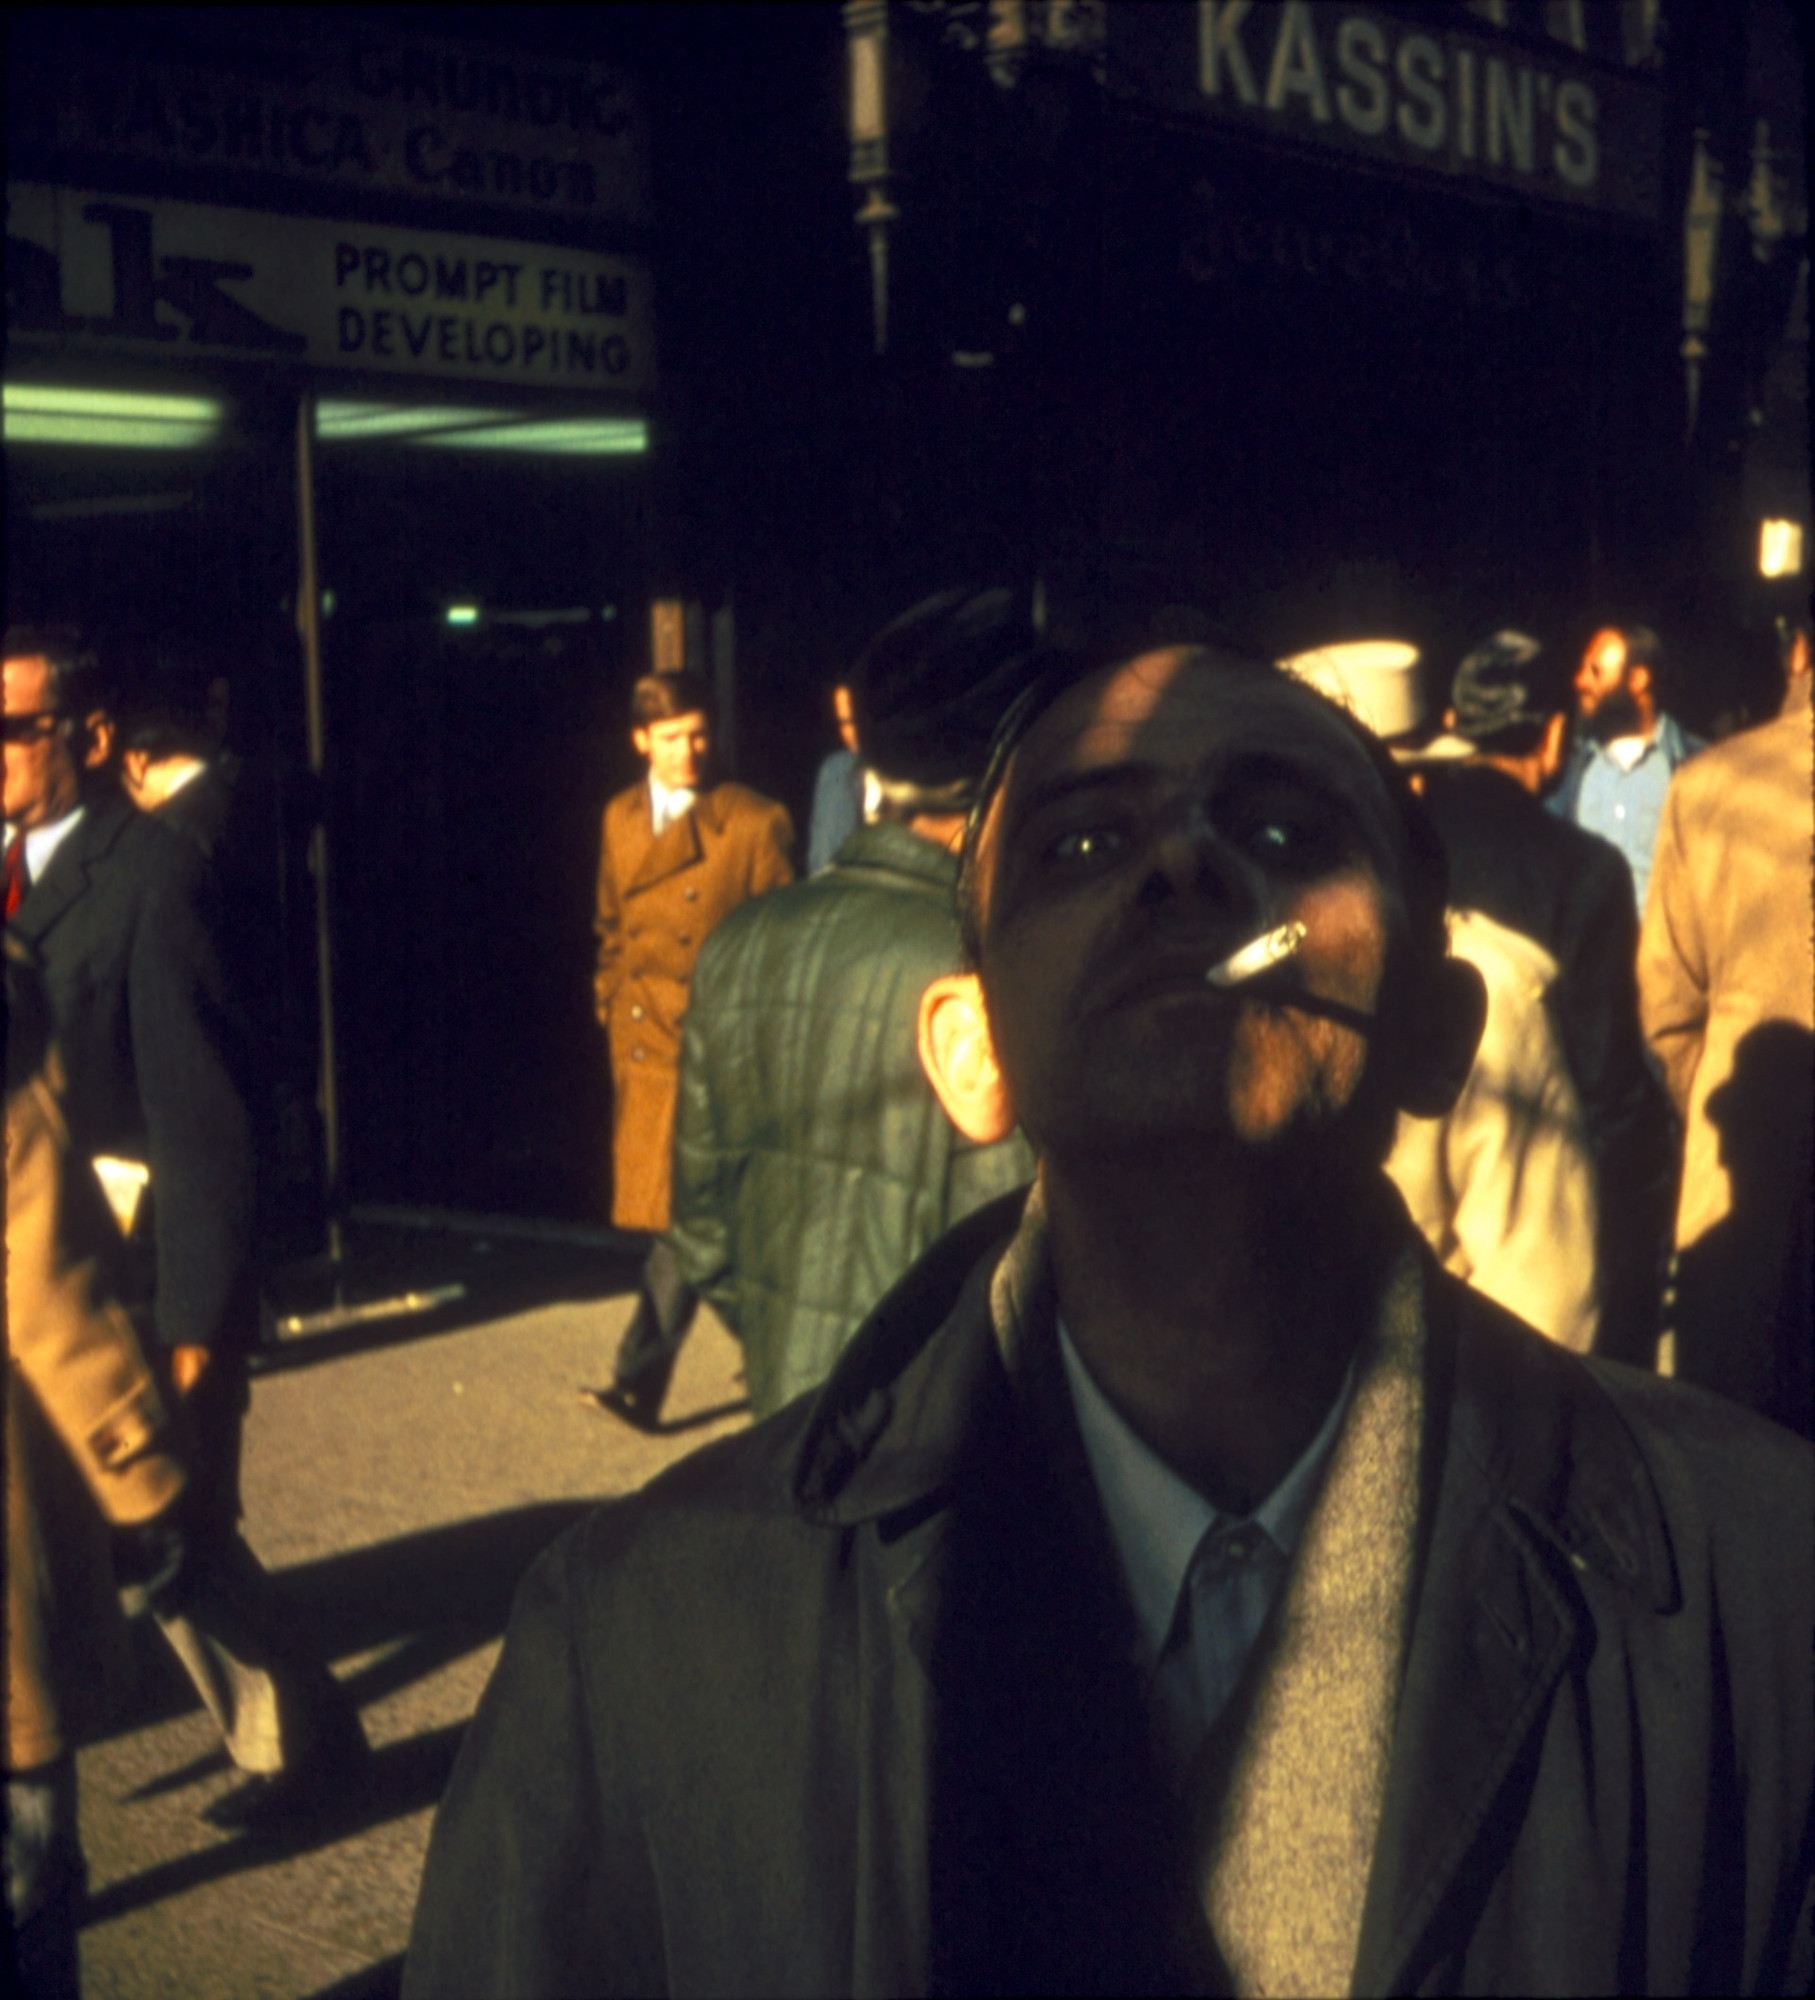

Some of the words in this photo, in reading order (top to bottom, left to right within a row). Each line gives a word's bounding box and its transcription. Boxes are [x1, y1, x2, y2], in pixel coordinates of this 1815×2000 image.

[1197, 0, 1599, 188] KASSIN'S
[404, 125, 598, 205] Canon
[335, 242, 523, 306] PROMPT
[541, 269, 629, 318] FILM
[337, 306, 632, 377] DEVELOPING
